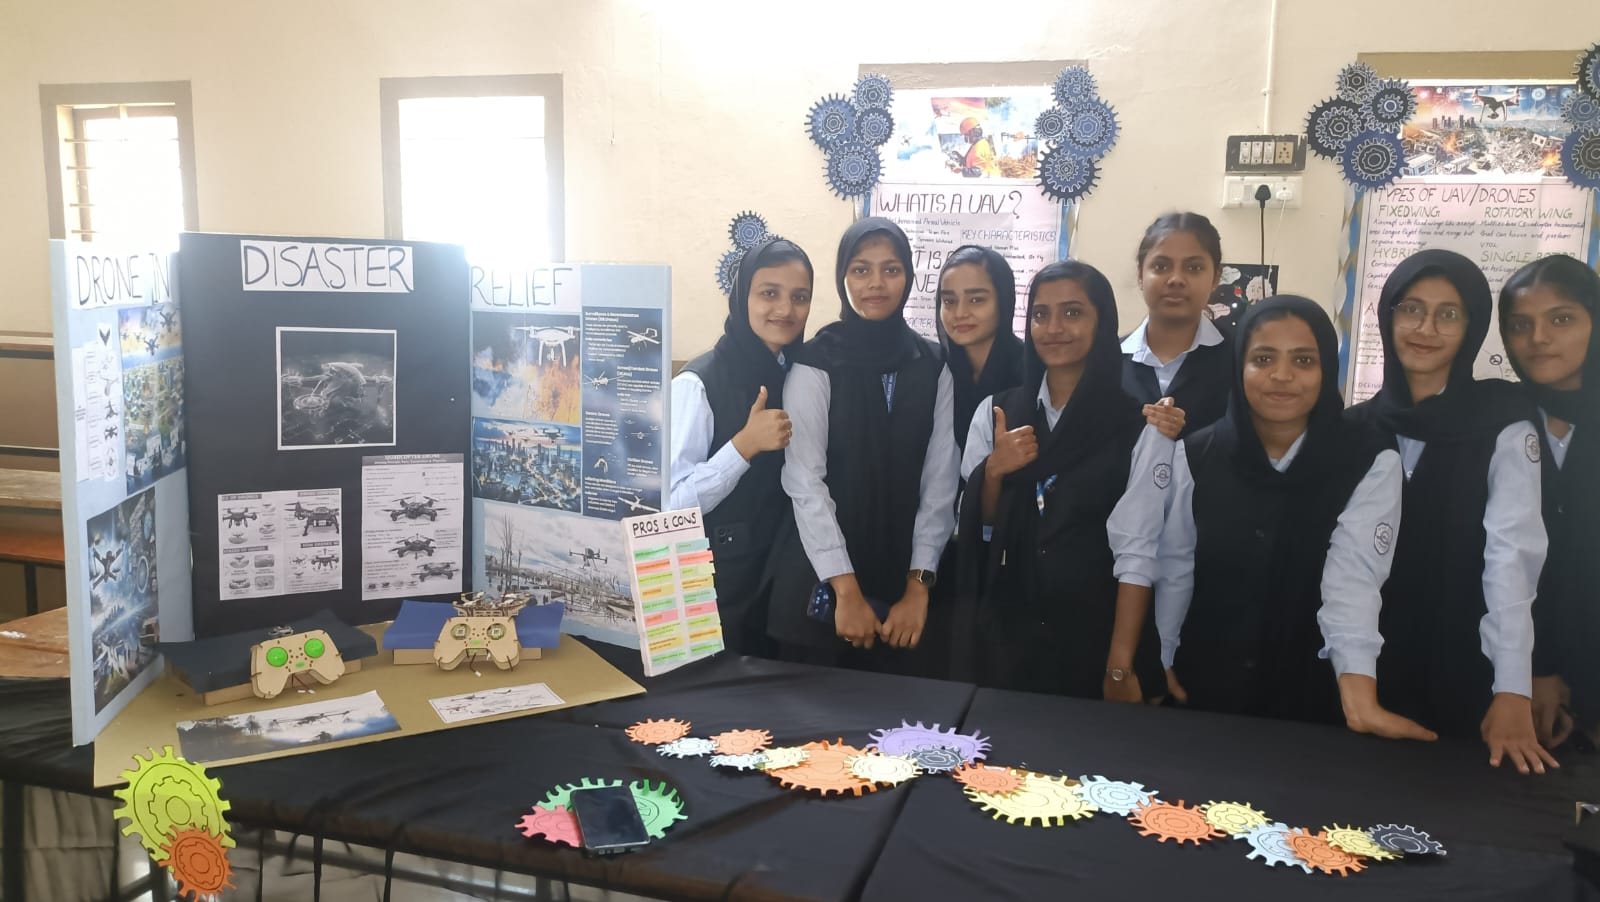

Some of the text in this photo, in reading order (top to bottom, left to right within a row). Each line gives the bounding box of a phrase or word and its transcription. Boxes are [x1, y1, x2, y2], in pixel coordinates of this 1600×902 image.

[950, 194, 962, 214] A
[1377, 187, 1417, 203] TYPES
[1419, 187, 1437, 202] OF
[1484, 206, 1574, 220] ROTATORY WING
[961, 229, 1057, 242] KEY CHARACTERISTICS
[928, 250, 943, 271] IS
[1480, 250, 1532, 263] SINGLE
[243, 244, 414, 292] DISASTER
[75, 252, 173, 306] DRONE IN
[470, 265, 573, 308] RELIEF
[632, 512, 698, 537] PROS & CONS
